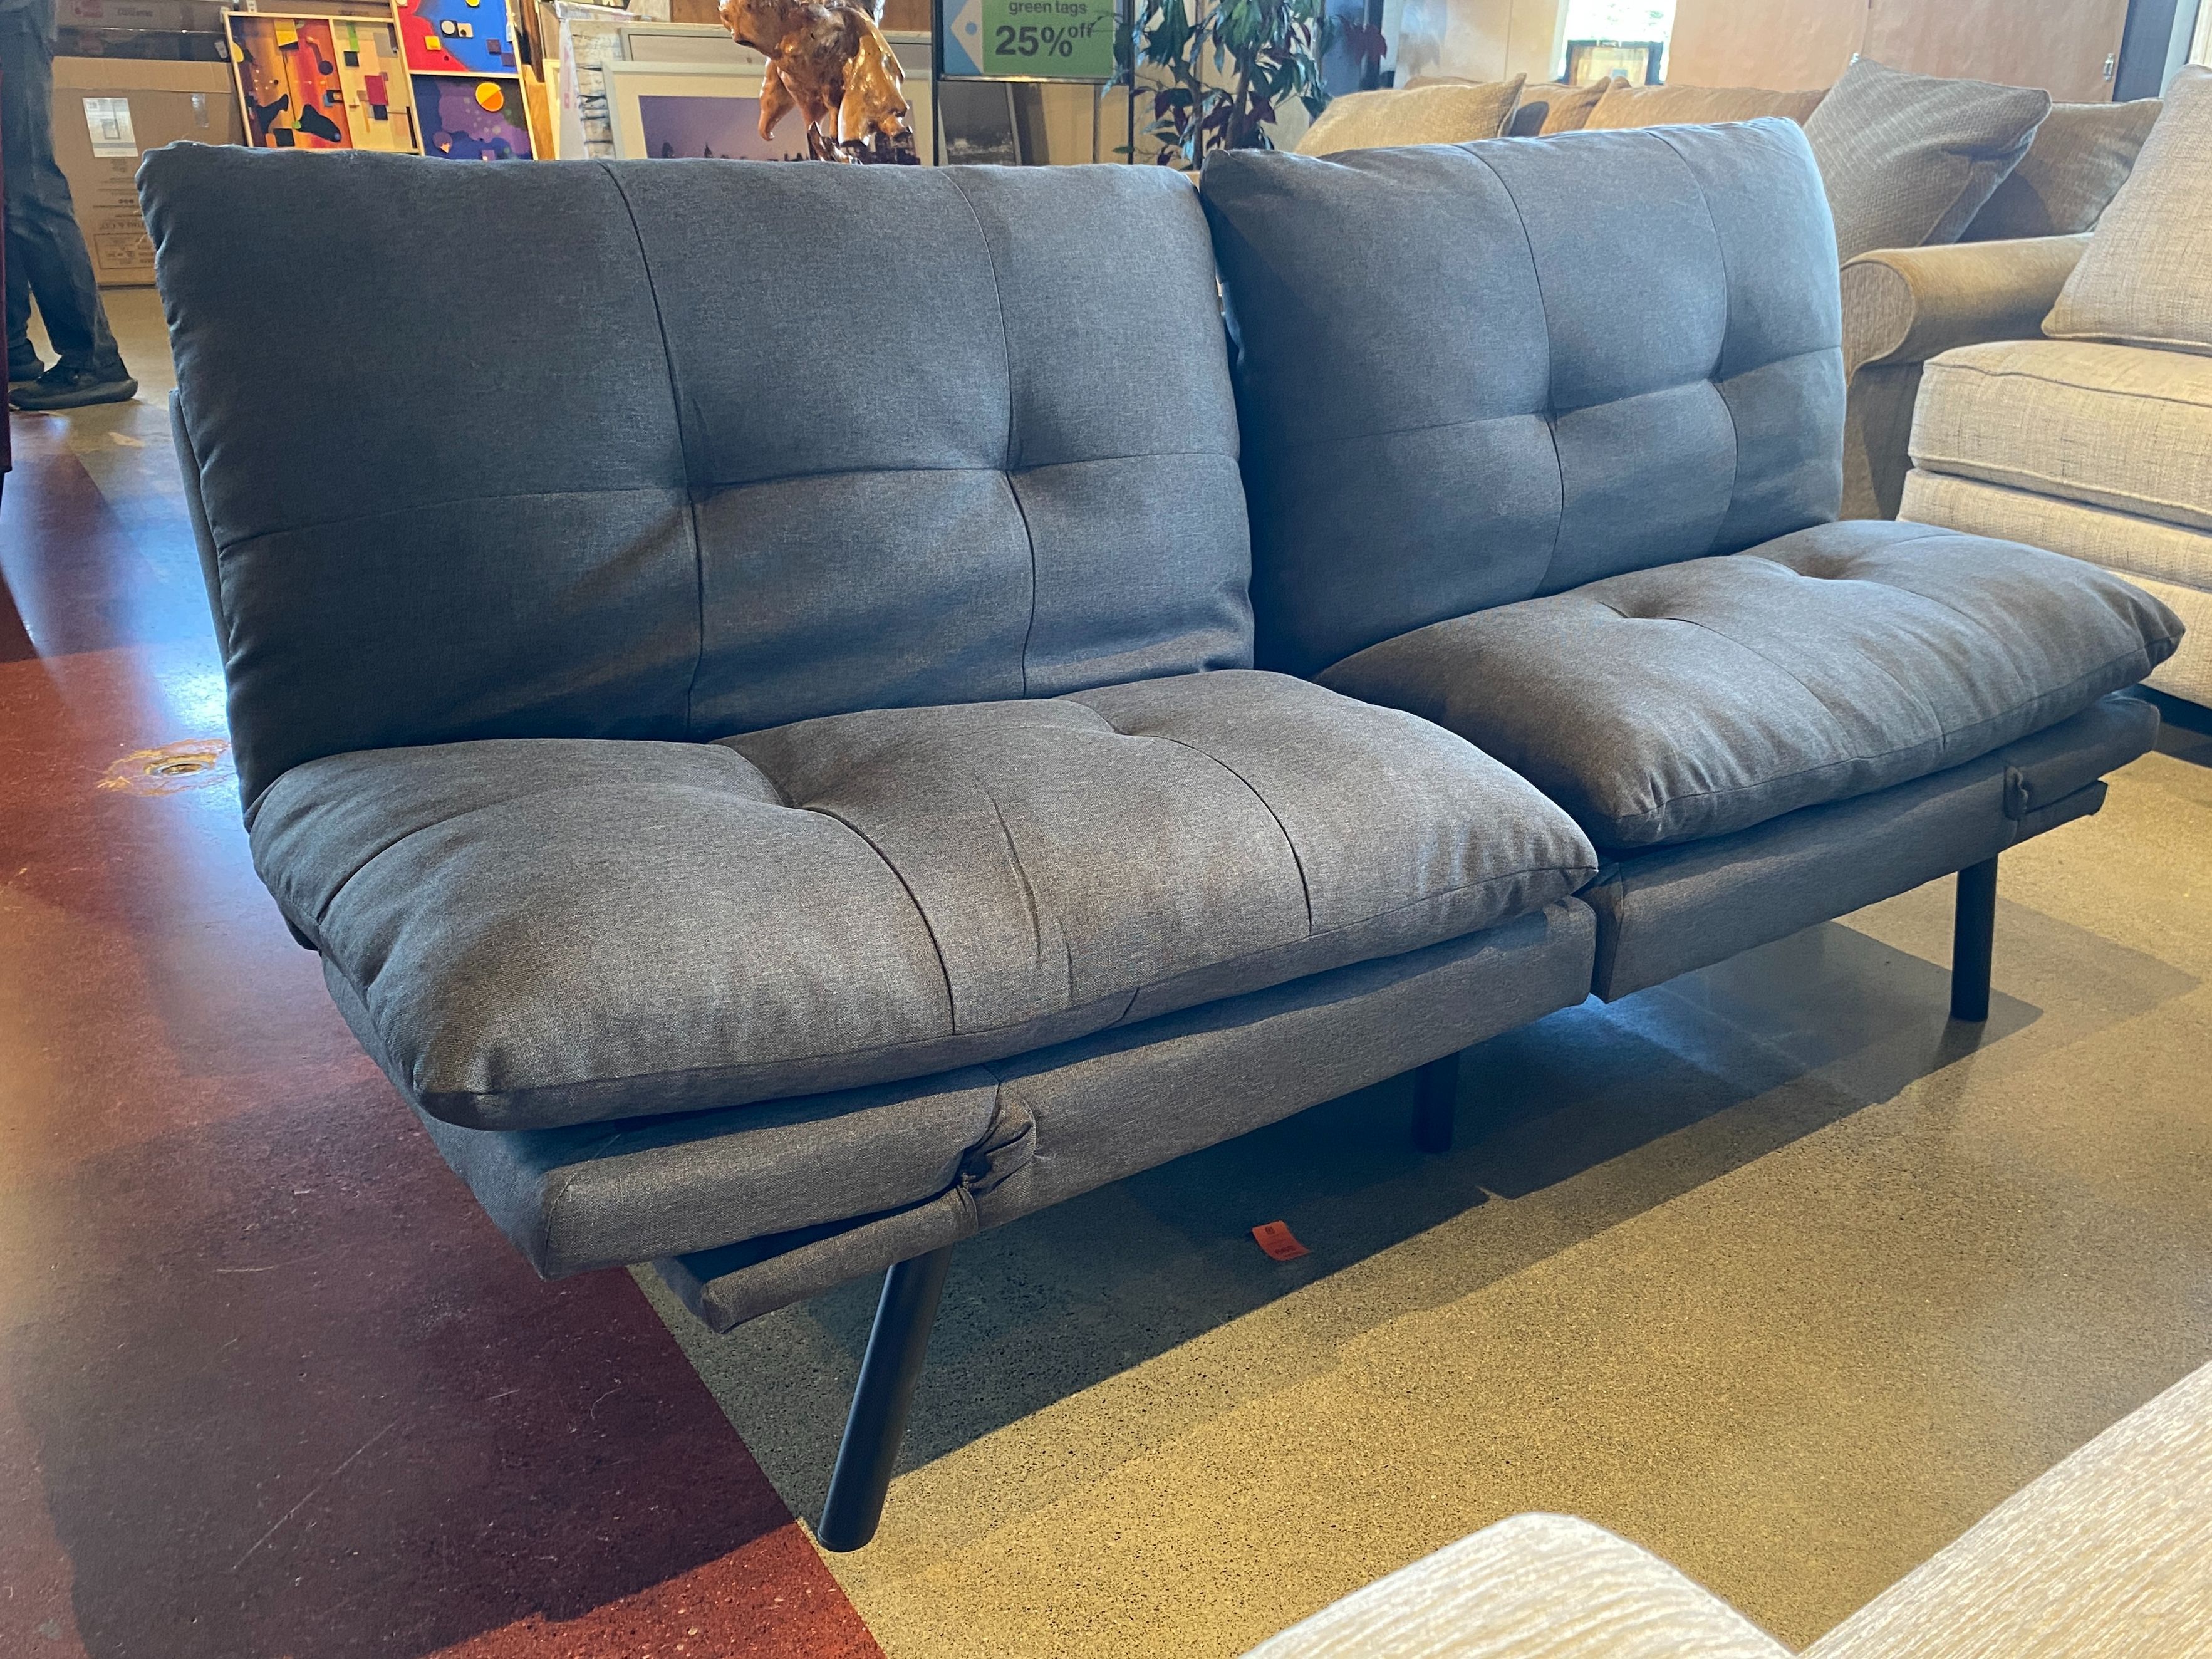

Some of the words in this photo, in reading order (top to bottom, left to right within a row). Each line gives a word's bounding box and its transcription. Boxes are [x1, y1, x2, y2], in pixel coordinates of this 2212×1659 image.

[1009, 1, 1051, 14] green
[1056, 1, 1087, 16] tags
[995, 25, 1072, 57] 25%
[1068, 23, 1093, 38] off
